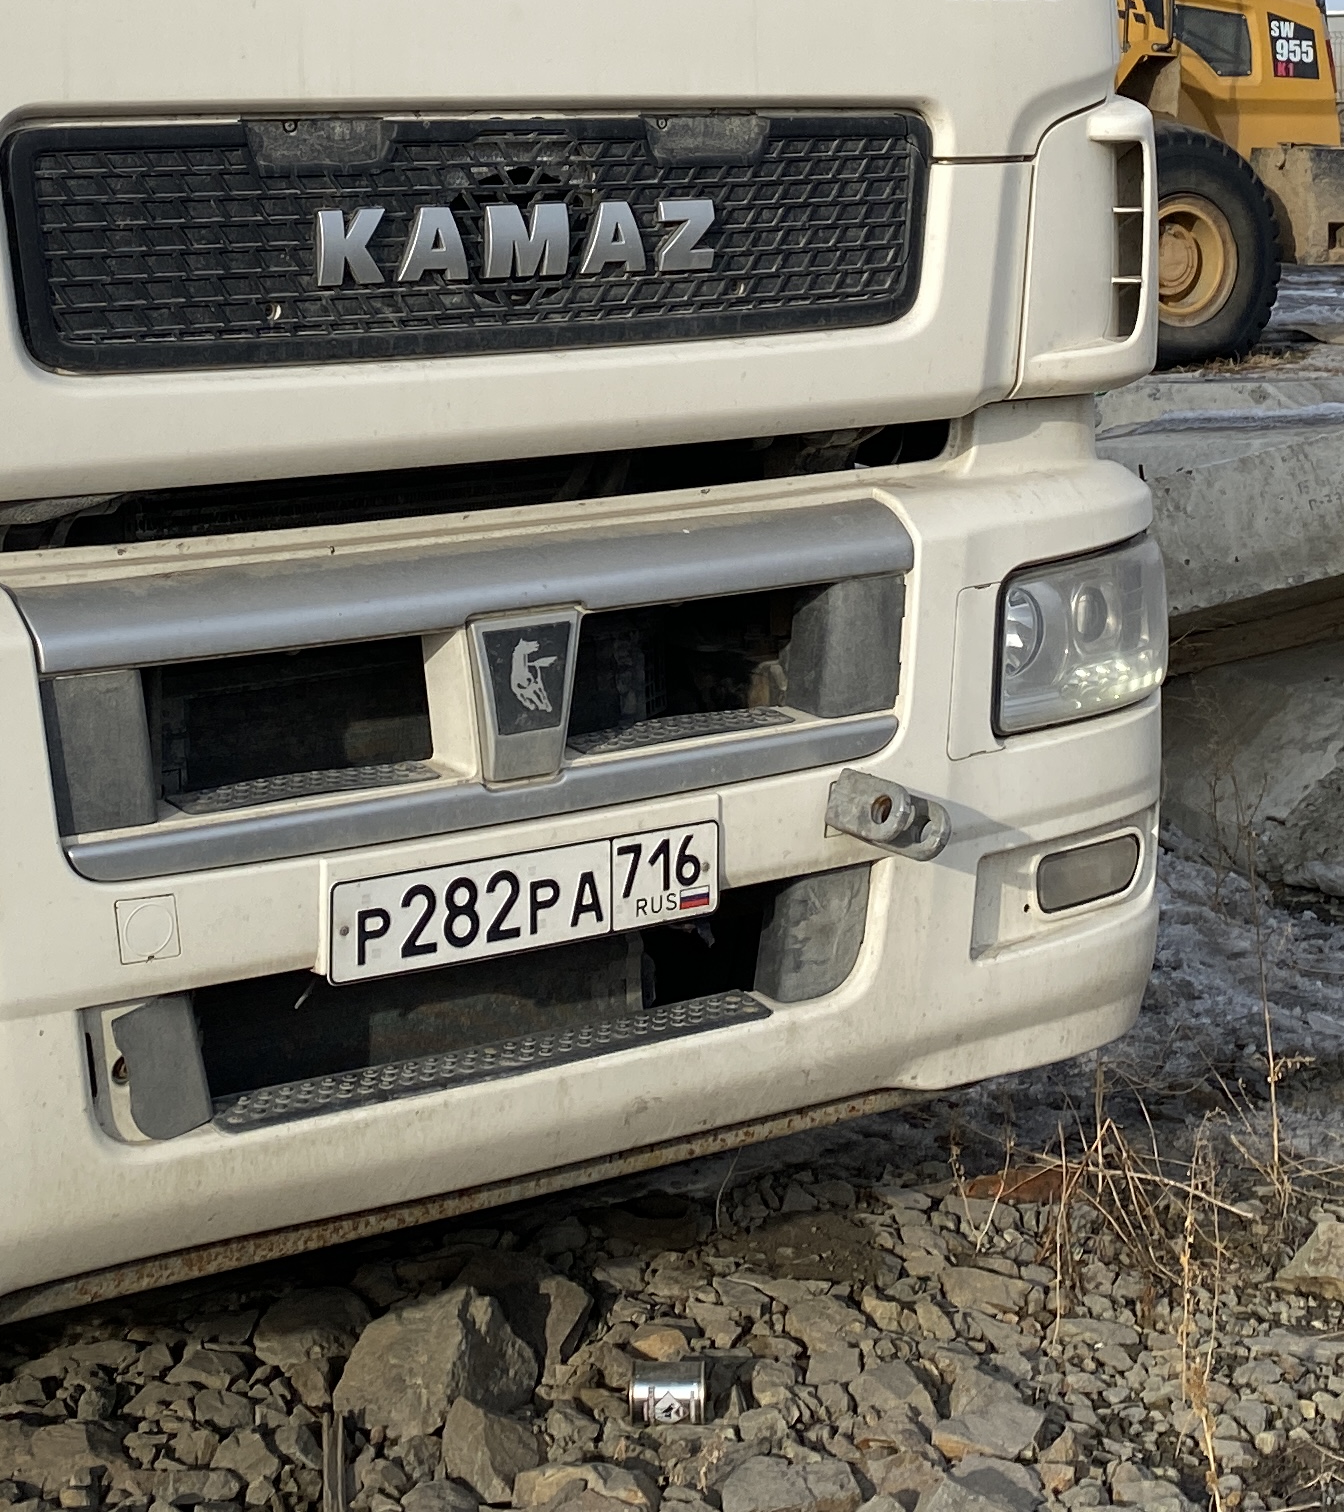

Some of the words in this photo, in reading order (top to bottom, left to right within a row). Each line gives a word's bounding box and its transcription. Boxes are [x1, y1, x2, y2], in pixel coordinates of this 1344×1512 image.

[1270, 20, 1295, 39] SW
[1275, 38, 1314, 63] 955
[315, 198, 717, 287] KAMAZ
[616, 834, 702, 899] 716
[635, 893, 678, 918] RUS
